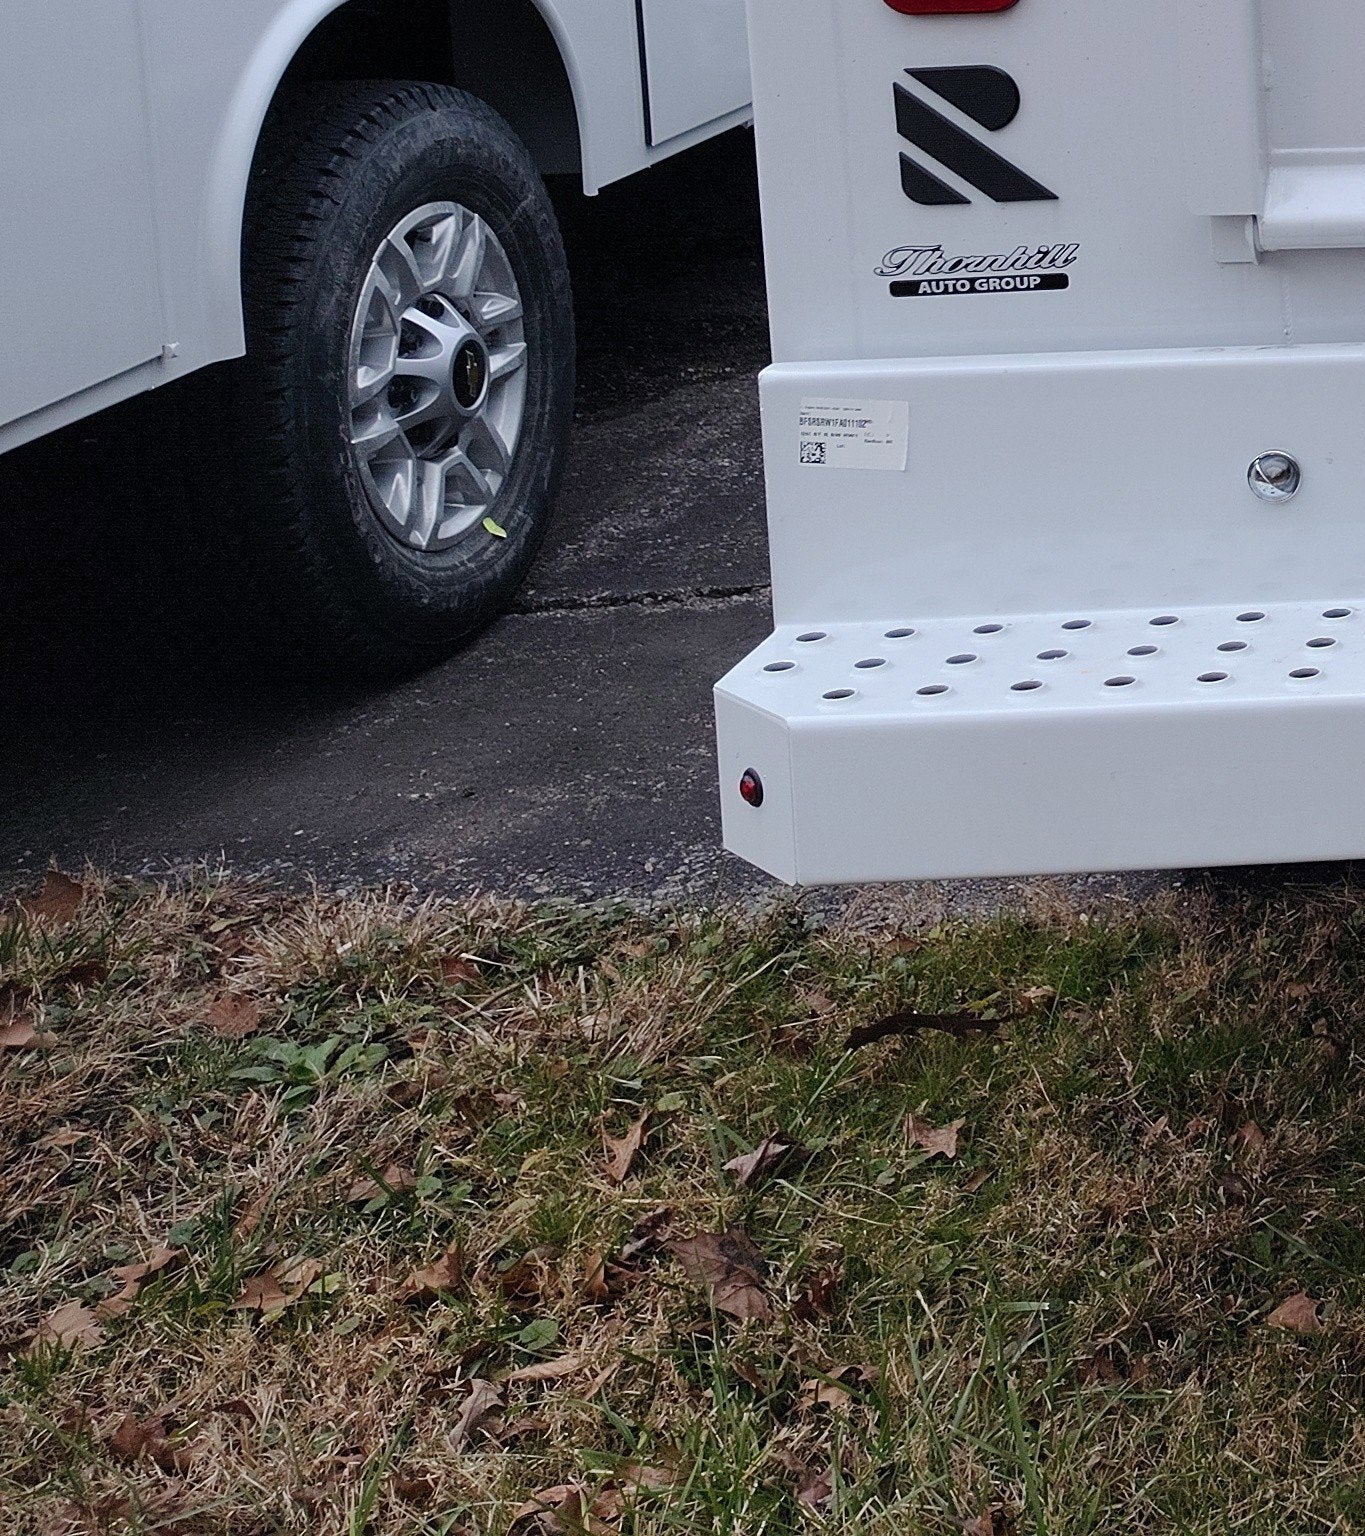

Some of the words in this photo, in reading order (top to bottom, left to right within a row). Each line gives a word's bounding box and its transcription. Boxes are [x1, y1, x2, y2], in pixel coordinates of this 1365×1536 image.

[873, 243, 1080, 277] Thornhill
[918, 280, 971, 294] AUTO
[974, 276, 1041, 291] GROUP
